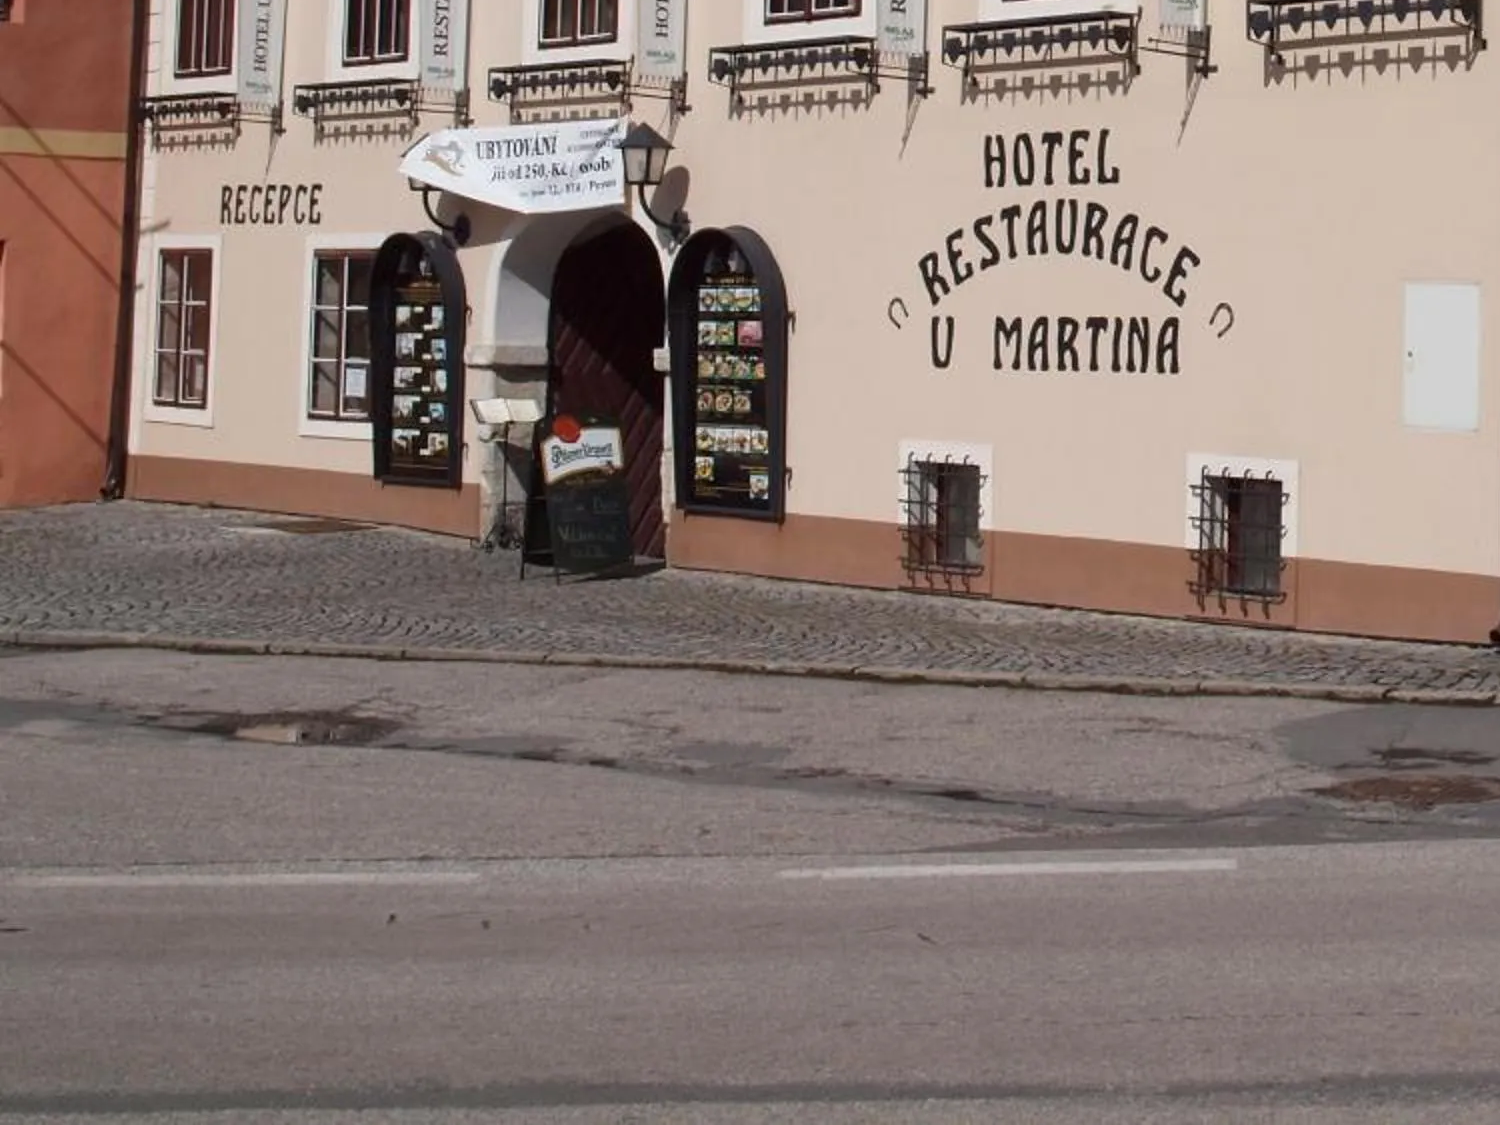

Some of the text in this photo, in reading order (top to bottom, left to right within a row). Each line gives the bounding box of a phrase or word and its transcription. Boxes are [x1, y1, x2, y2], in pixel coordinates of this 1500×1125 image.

[252, 10, 271, 73] HOTEL
[508, 164, 523, 181] od
[983, 128, 1120, 188] HOTEL
[220, 183, 323, 225] RECEPCE
[917, 198, 1201, 308] RESTAURACE
[930, 315, 1181, 375] U MARTINA
